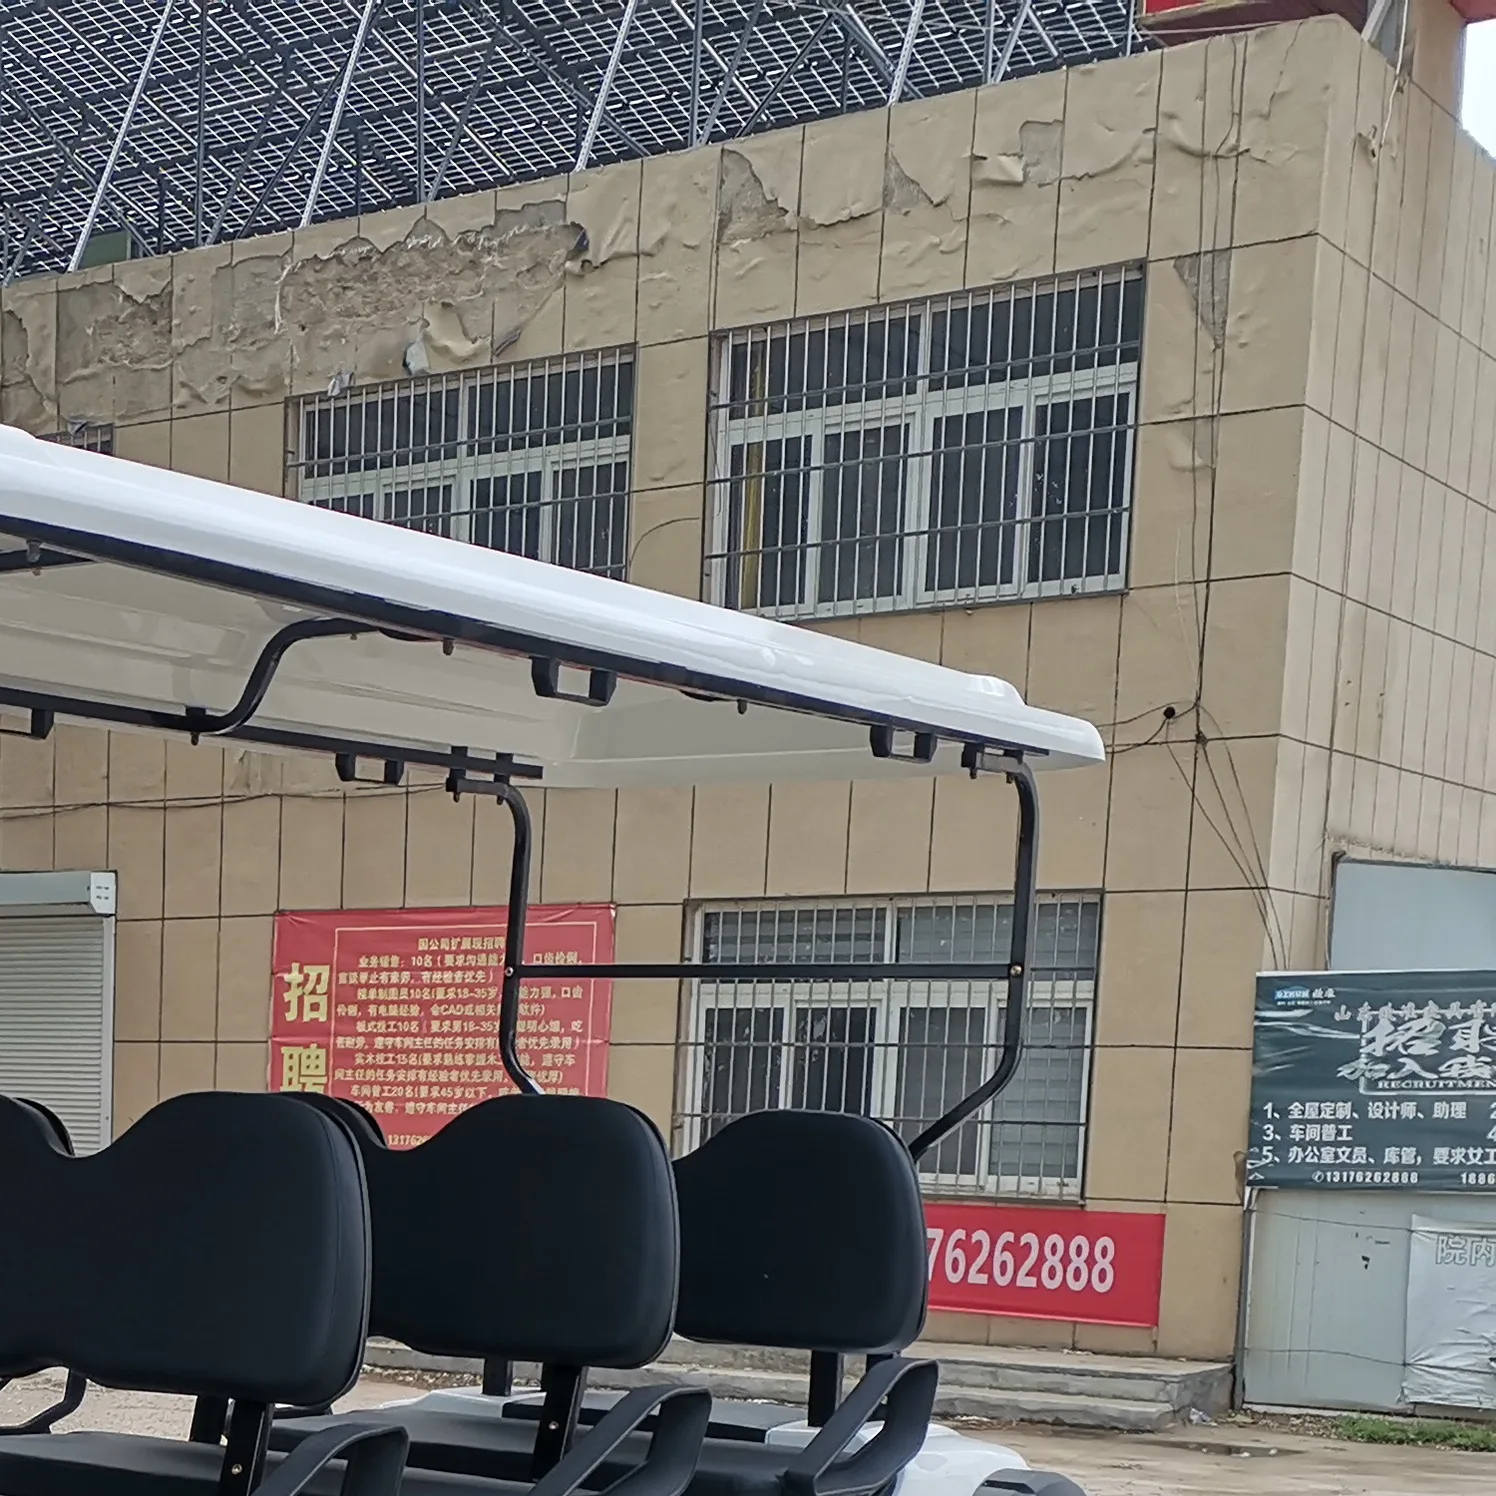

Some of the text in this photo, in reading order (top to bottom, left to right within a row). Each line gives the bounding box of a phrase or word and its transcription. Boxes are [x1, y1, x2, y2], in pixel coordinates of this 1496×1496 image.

[280, 961, 330, 1093] 招聘
[1325, 1170, 1419, 1184] 13176262888
[925, 1227, 1115, 1293] 76262888
[1435, 1234, 1496, 1267] 院内
